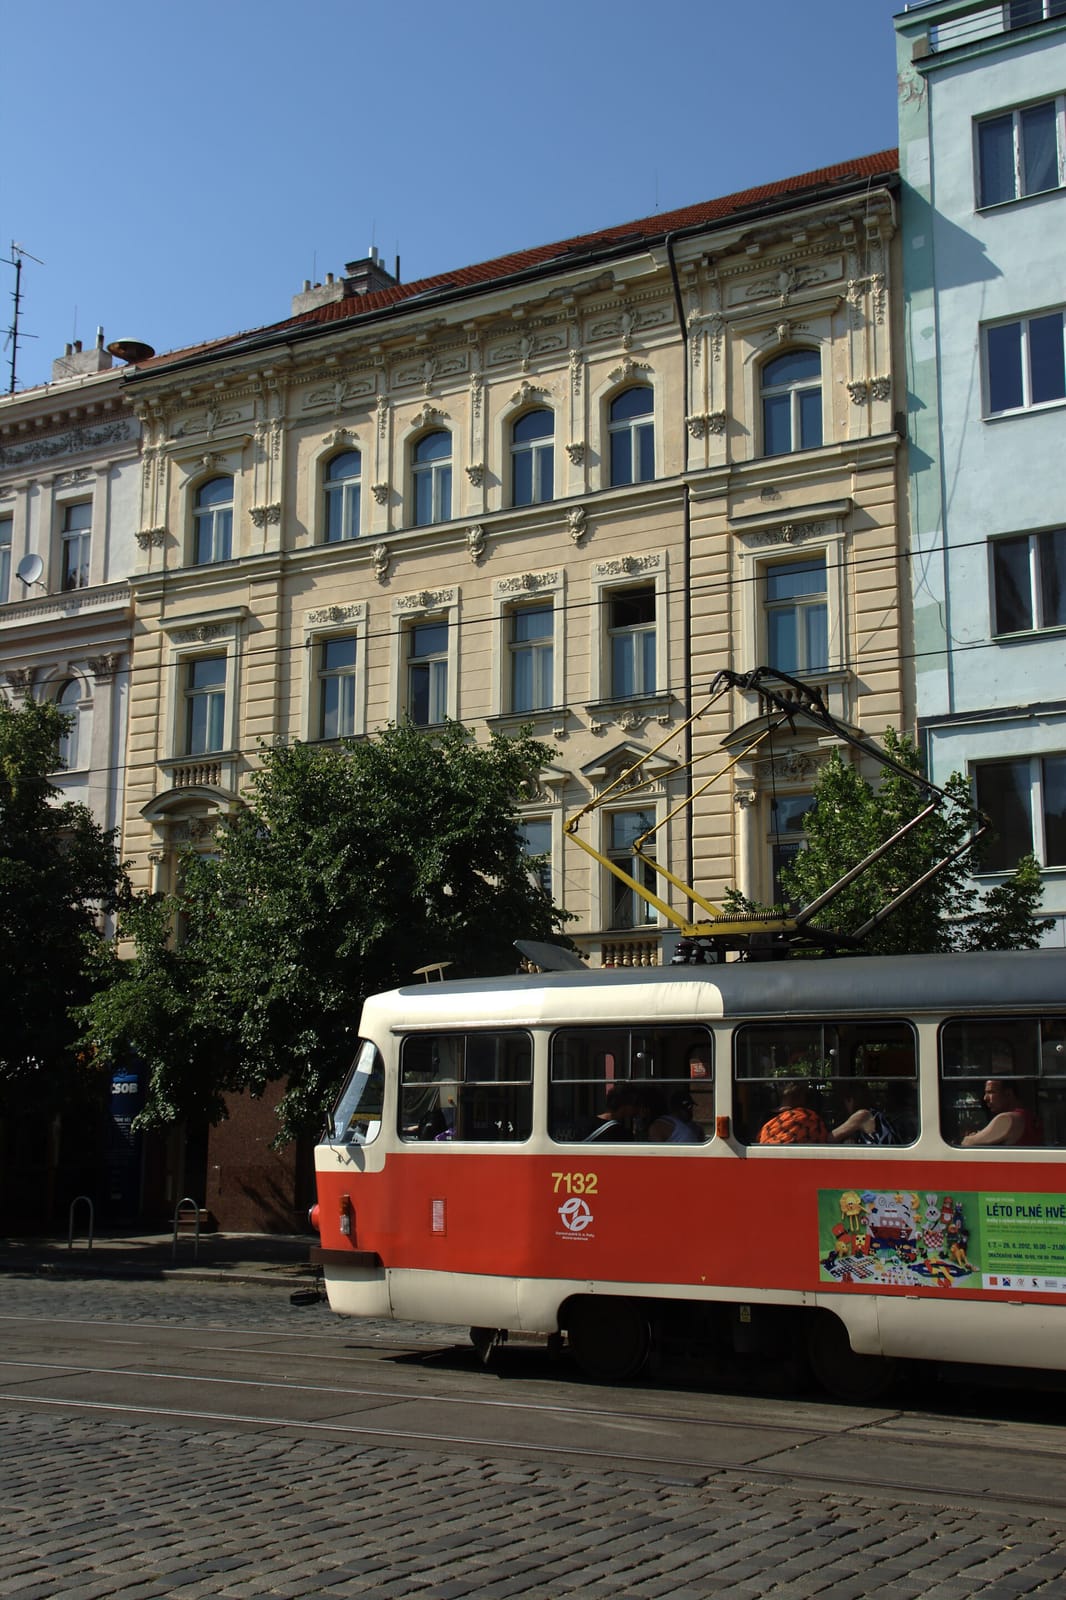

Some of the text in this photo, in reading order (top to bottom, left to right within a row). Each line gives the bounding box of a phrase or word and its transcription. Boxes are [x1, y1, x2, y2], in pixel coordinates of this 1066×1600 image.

[551, 1172, 598, 1194] 7132
[986, 1203, 1066, 1219] LÉTO PLNÉ HVĚ
